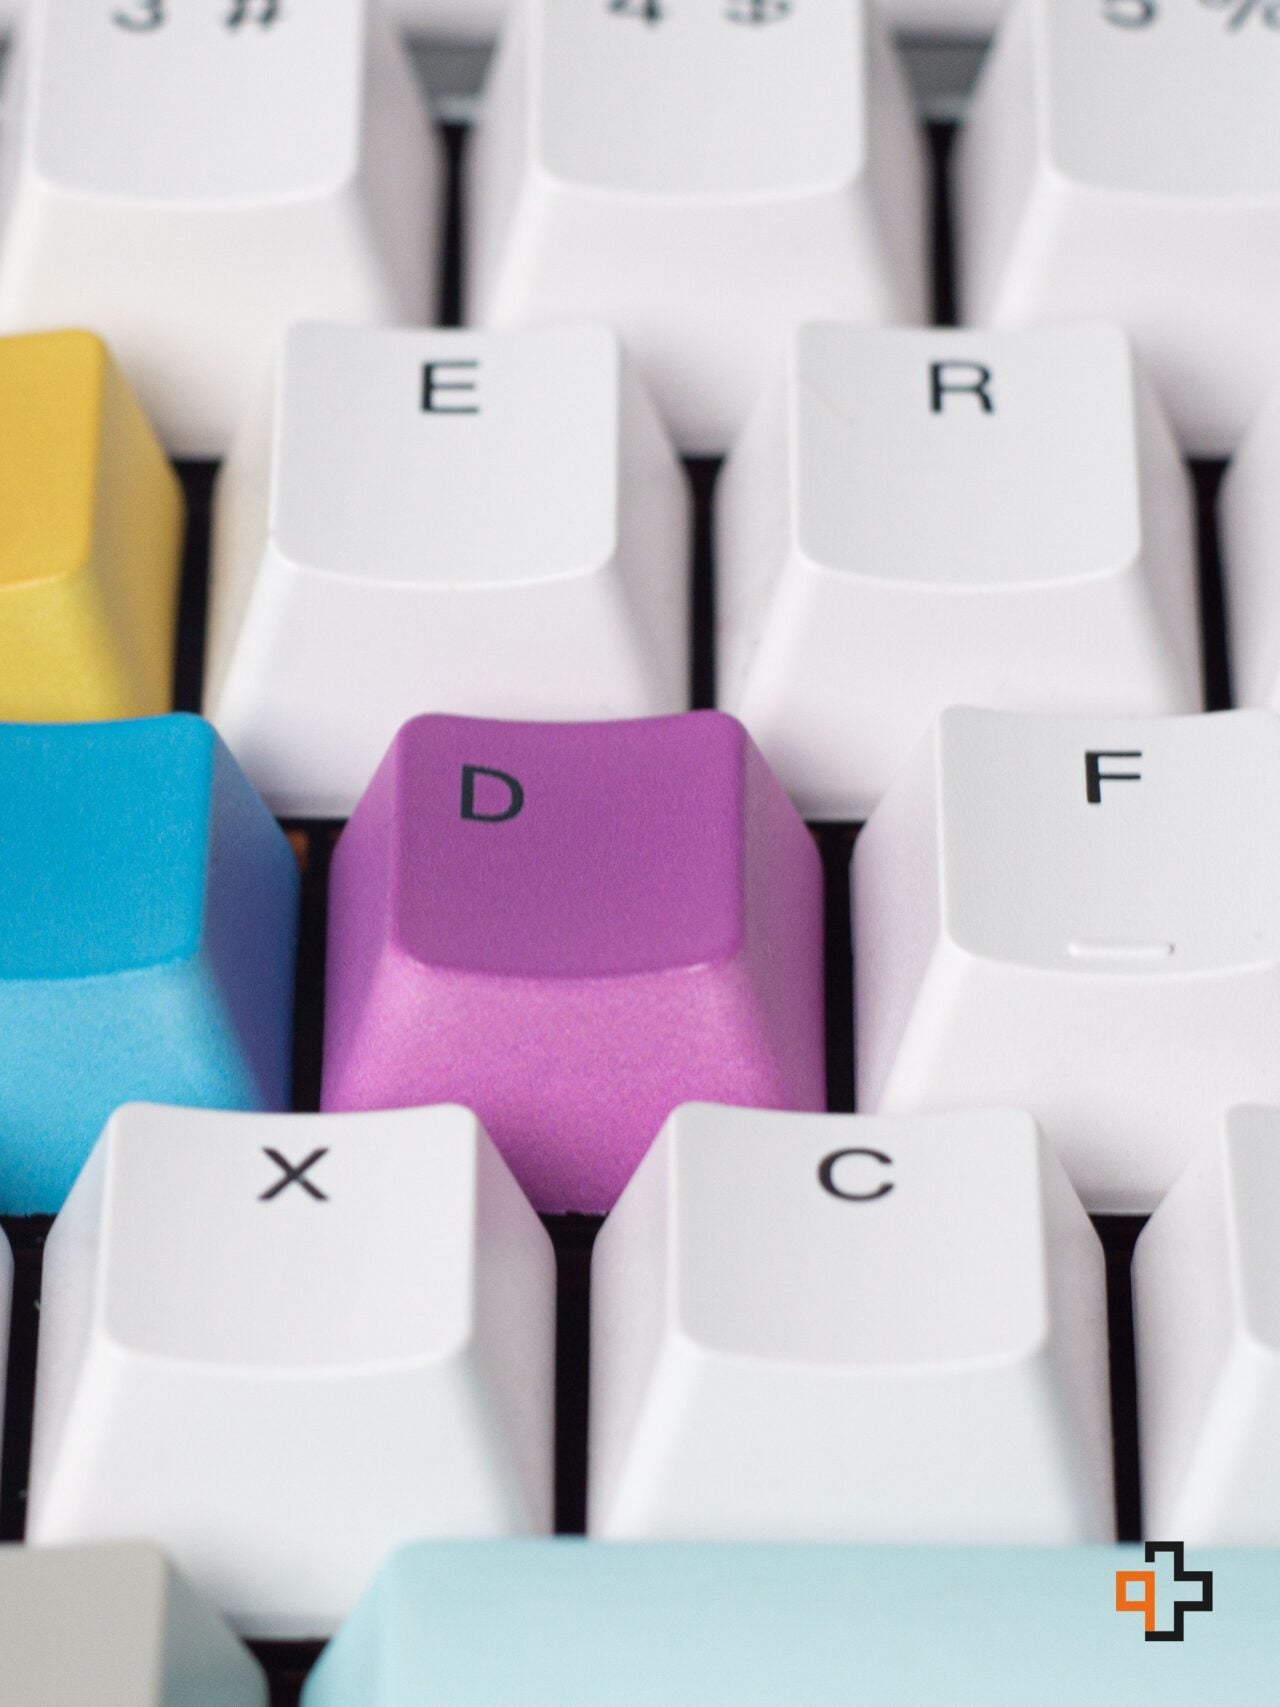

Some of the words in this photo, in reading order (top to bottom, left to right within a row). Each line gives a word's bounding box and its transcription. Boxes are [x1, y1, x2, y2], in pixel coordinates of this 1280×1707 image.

[420, 361, 481, 414] E
[928, 361, 995, 414] R
[459, 764, 526, 824] D
[1084, 750, 1144, 805] F
[259, 1147, 329, 1202] X
[816, 1147, 895, 1203] C
